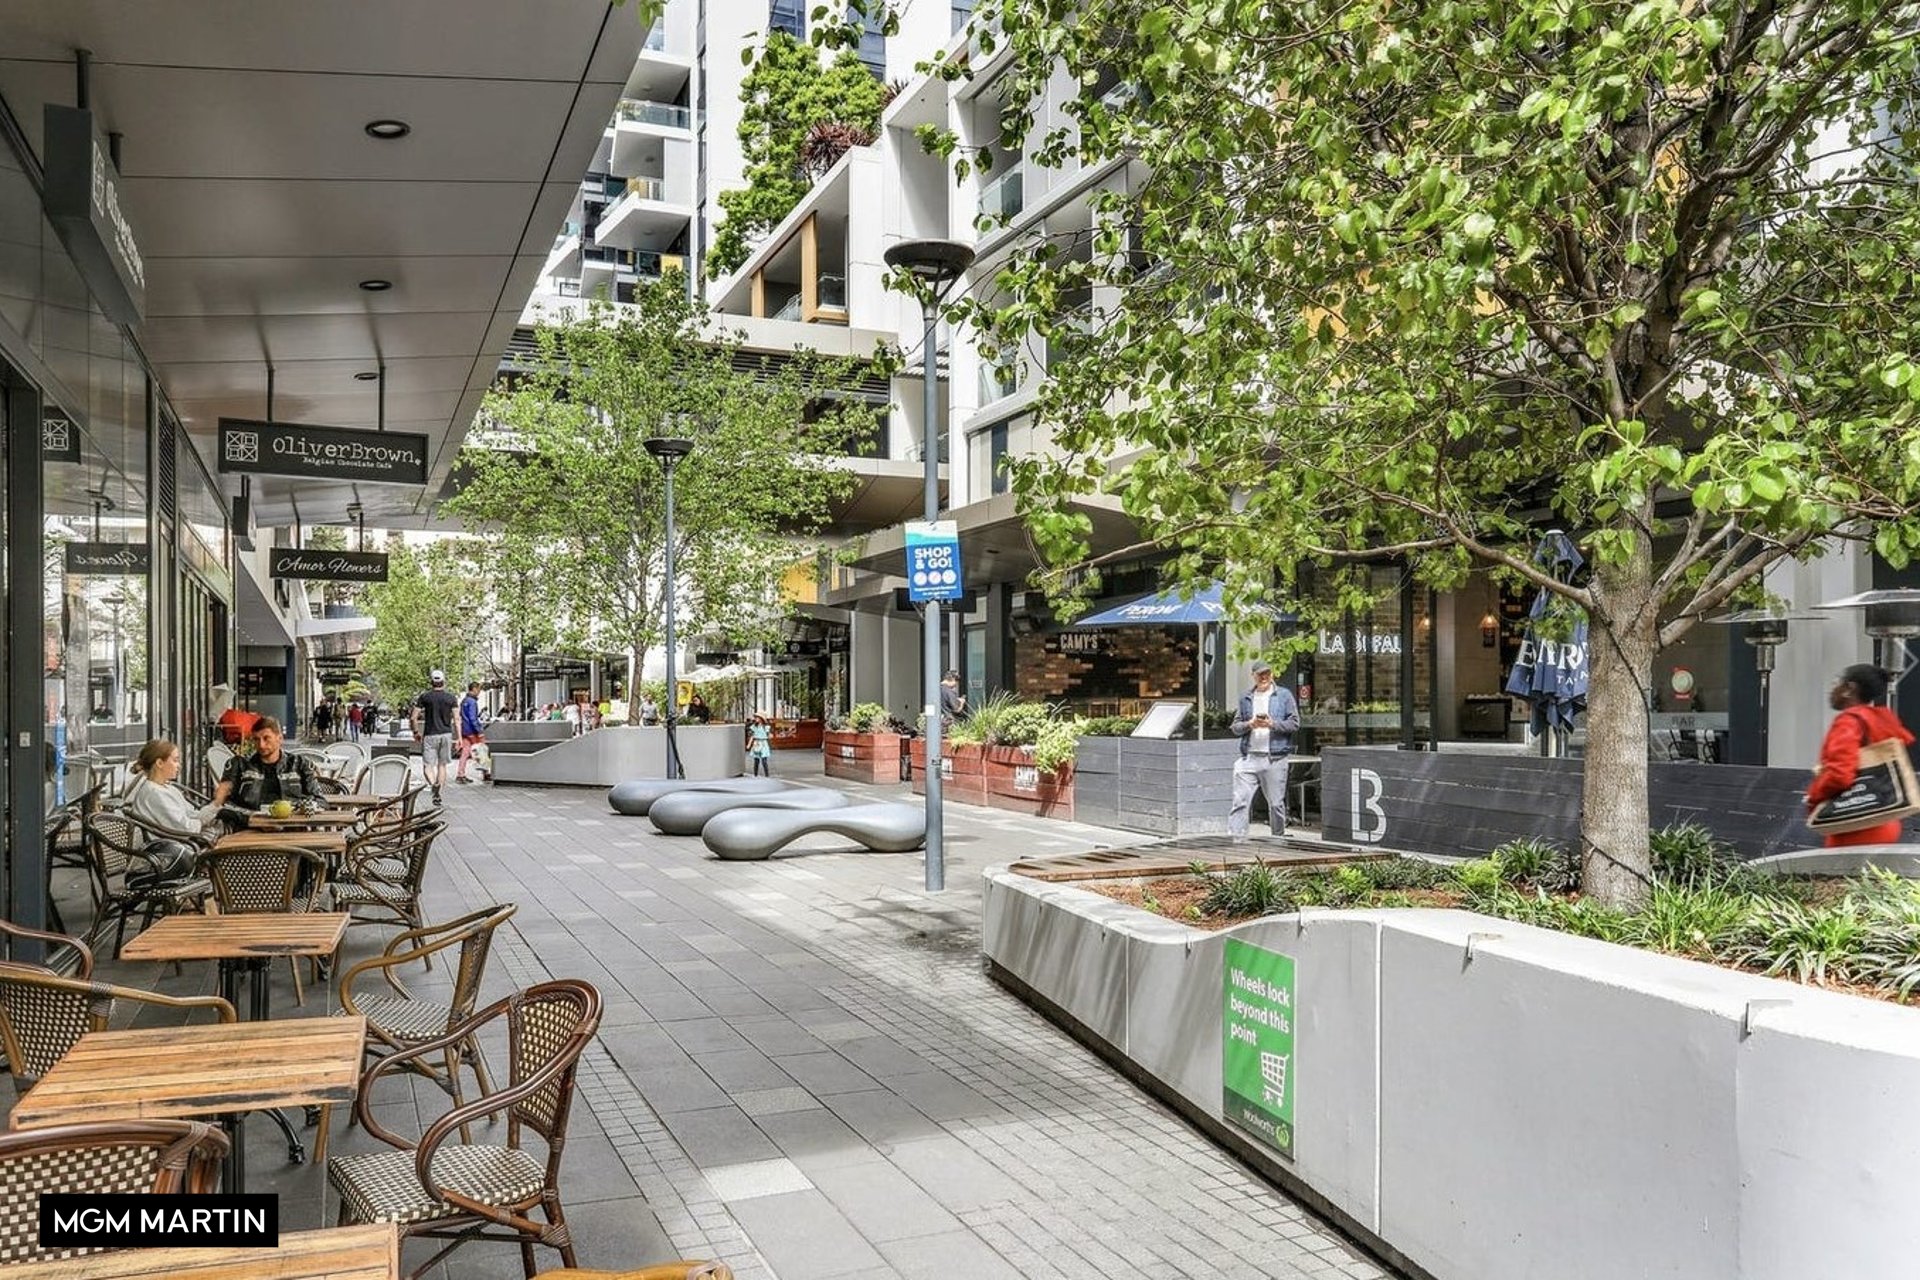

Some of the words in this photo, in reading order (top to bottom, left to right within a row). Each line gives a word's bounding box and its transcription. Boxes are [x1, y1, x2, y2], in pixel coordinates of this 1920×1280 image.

[277, 556, 327, 572] Amor
[914, 546, 952, 559] SHOP
[915, 559, 925, 571] &
[927, 557, 953, 570] GO!
[1351, 768, 1386, 842] B
[1231, 967, 1266, 997] Wheels
[1268, 981, 1290, 1008] lock
[1231, 992, 1268, 1025] beyond
[1269, 1009, 1290, 1034] this
[1231, 1022, 1257, 1046] point
